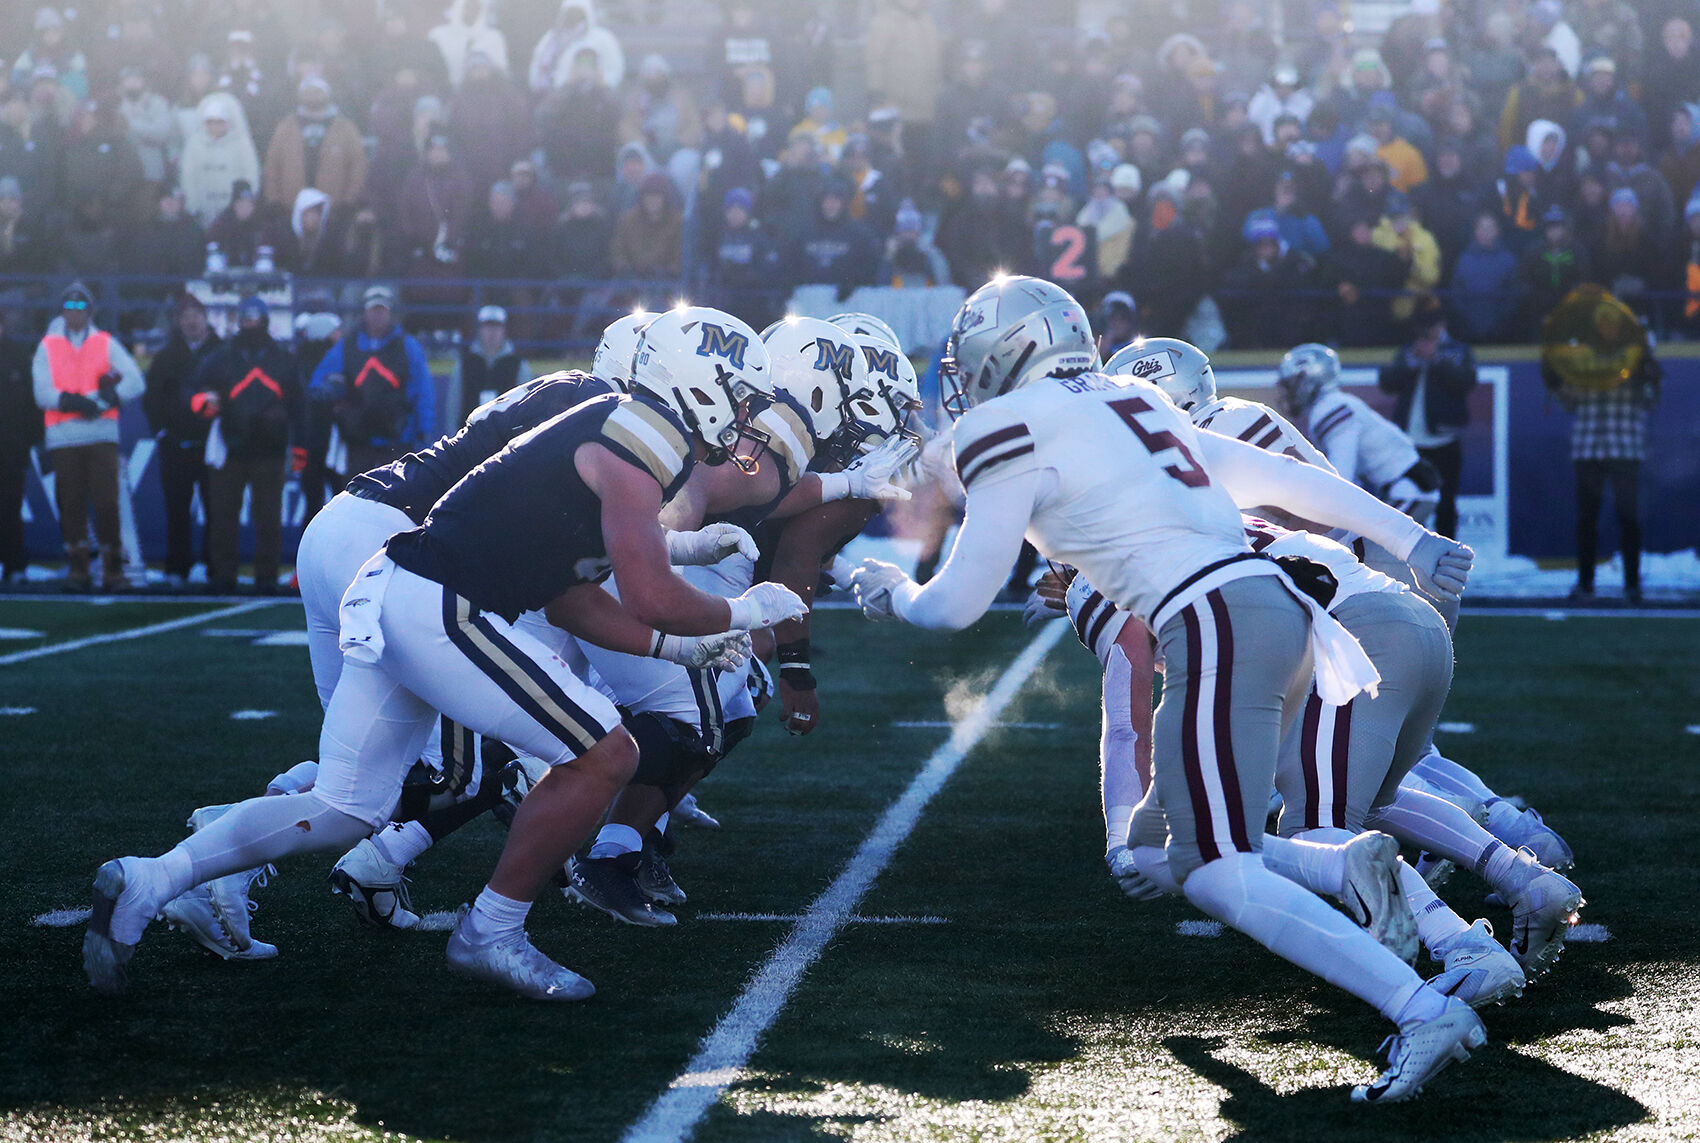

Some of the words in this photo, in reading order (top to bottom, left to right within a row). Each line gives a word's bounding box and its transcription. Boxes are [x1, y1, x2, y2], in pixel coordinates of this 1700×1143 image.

[1051, 226, 1086, 278] 2
[639, 353, 650, 366] 80
[696, 322, 749, 371] M
[813, 337, 855, 381] M
[860, 345, 899, 382] M
[1131, 357, 1163, 379] Griz
[1106, 397, 1210, 488] 5
